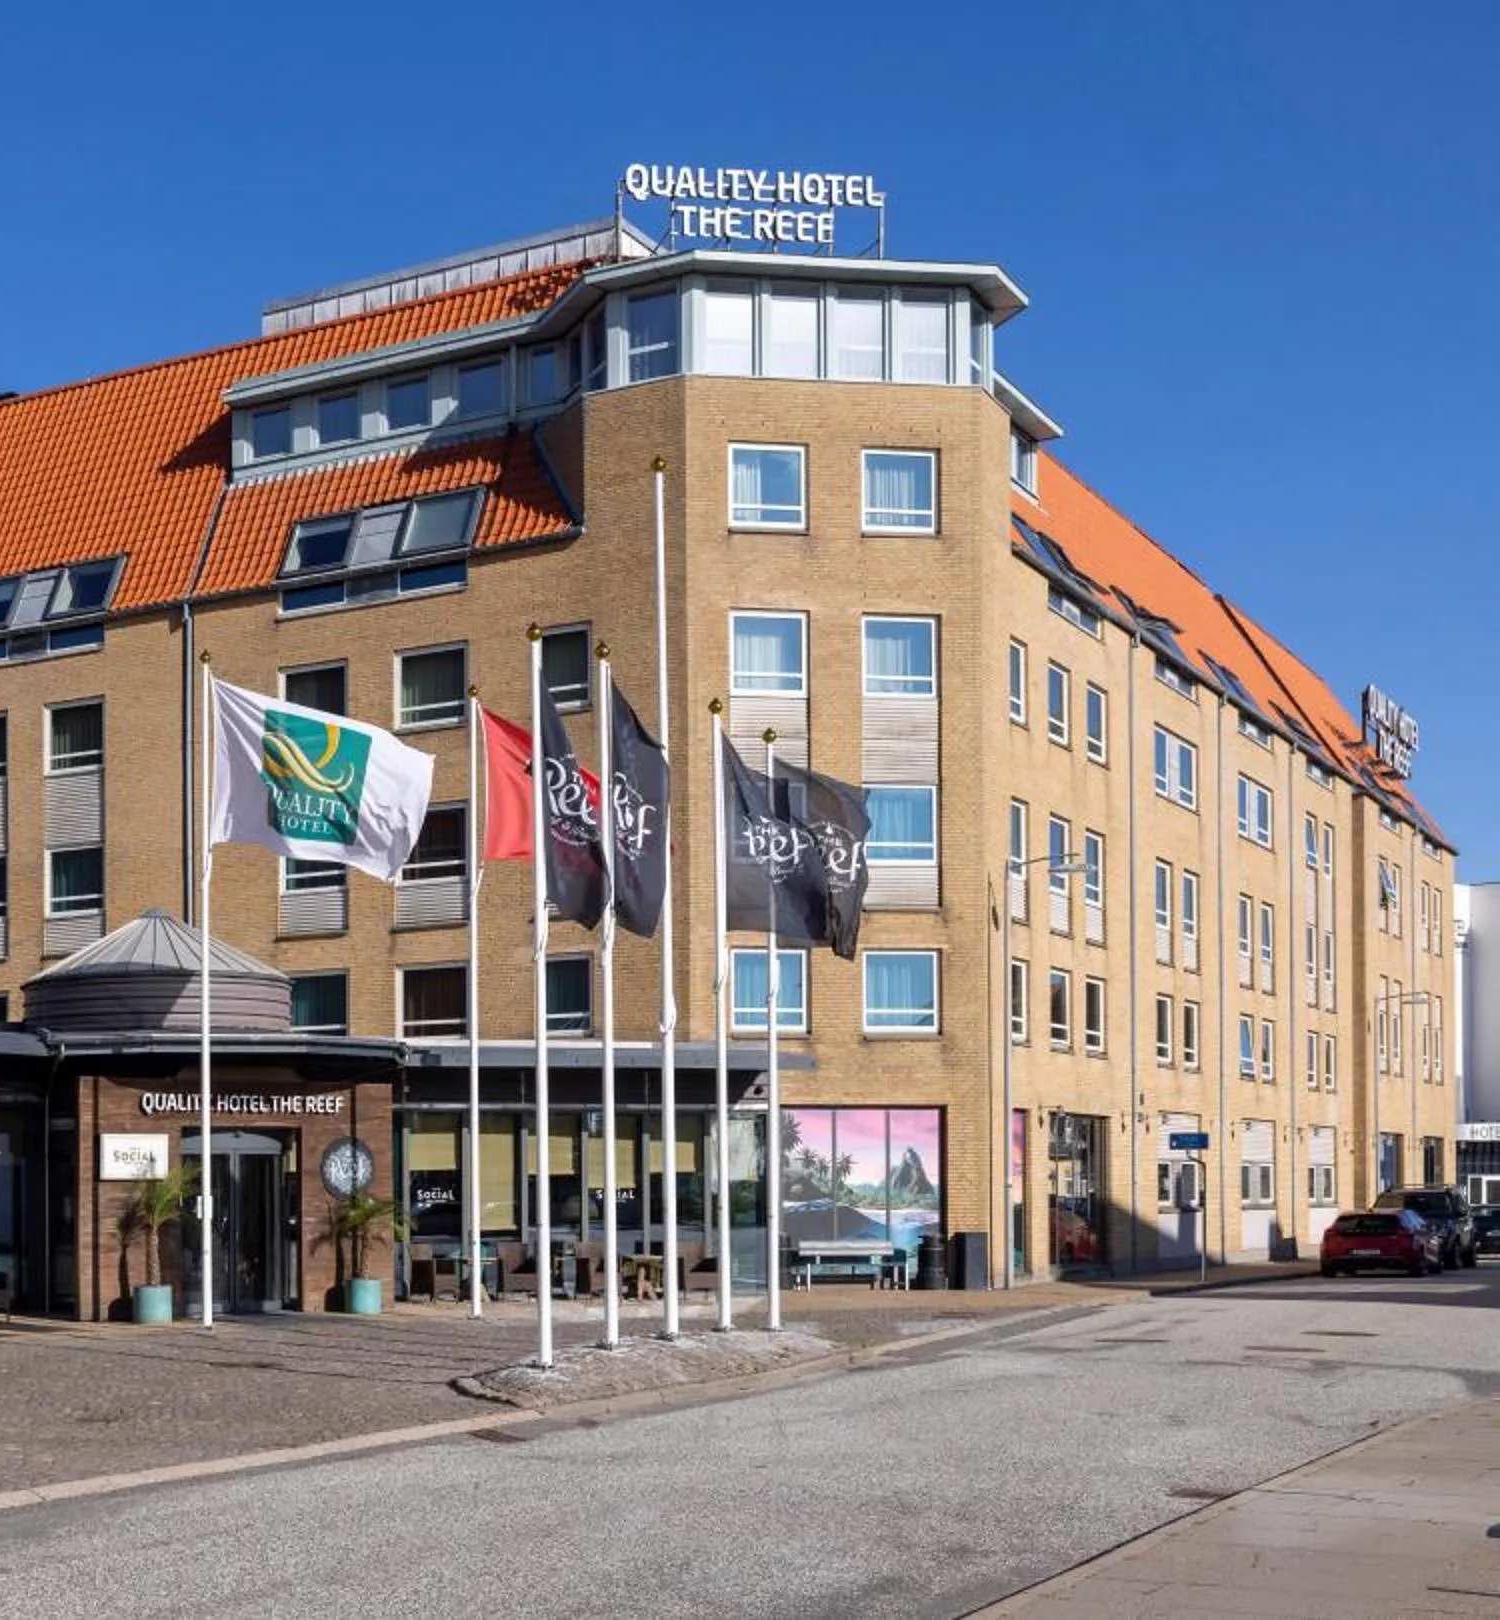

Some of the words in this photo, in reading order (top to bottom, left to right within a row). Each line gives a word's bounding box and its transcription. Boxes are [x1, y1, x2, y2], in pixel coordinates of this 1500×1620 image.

[625, 163, 767, 203] QUALITY
[776, 171, 884, 207] HOTEL
[675, 204, 751, 239] THE
[753, 208, 835, 243] REEF
[141, 1092, 212, 1115] QUALIT
[217, 1094, 269, 1113] HOTEL
[271, 1095, 302, 1113] THE
[305, 1096, 345, 1113] REEF
[596, 1188, 636, 1200] SIAL
